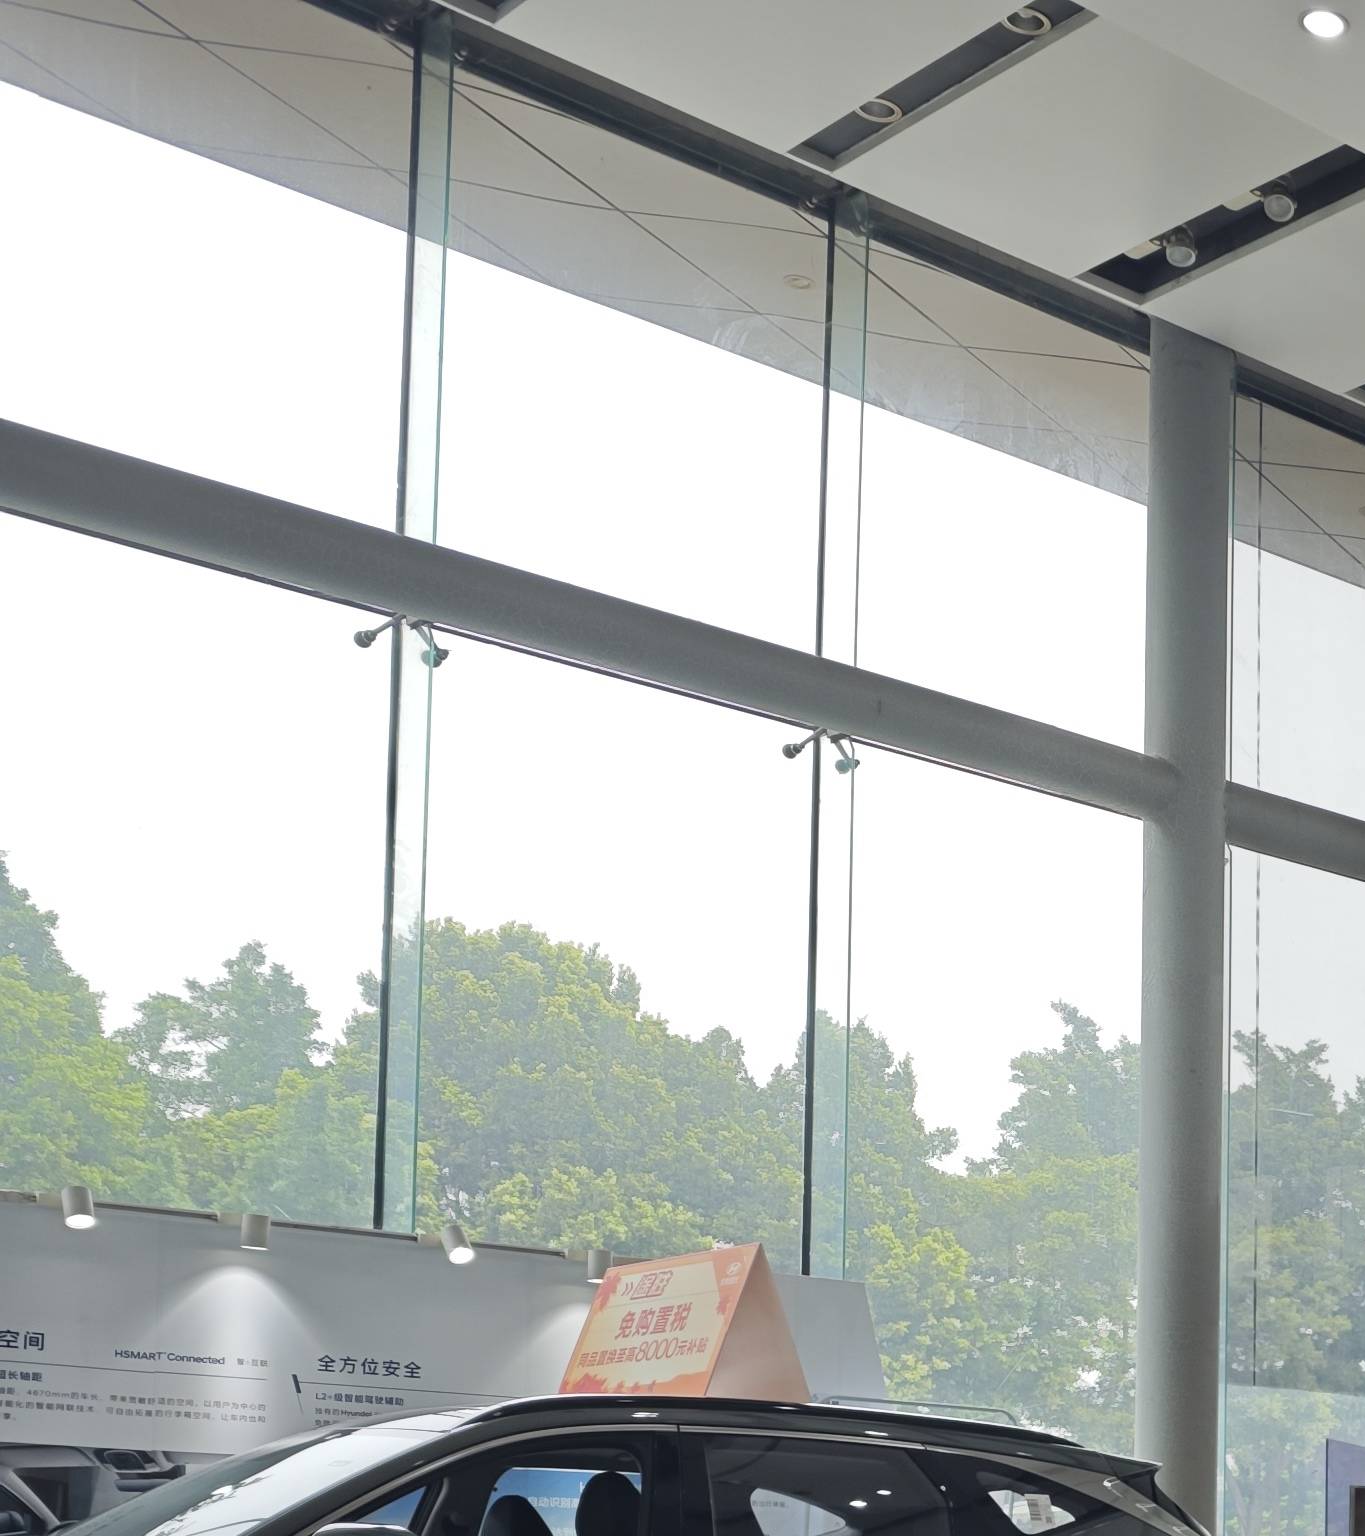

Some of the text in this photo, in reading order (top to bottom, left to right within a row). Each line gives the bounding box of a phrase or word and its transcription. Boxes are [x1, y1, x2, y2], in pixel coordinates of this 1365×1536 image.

[615, 1303, 693, 1340] 免购置税
[0, 1330, 45, 1351] 空间
[317, 1354, 422, 1379] 全方位安全
